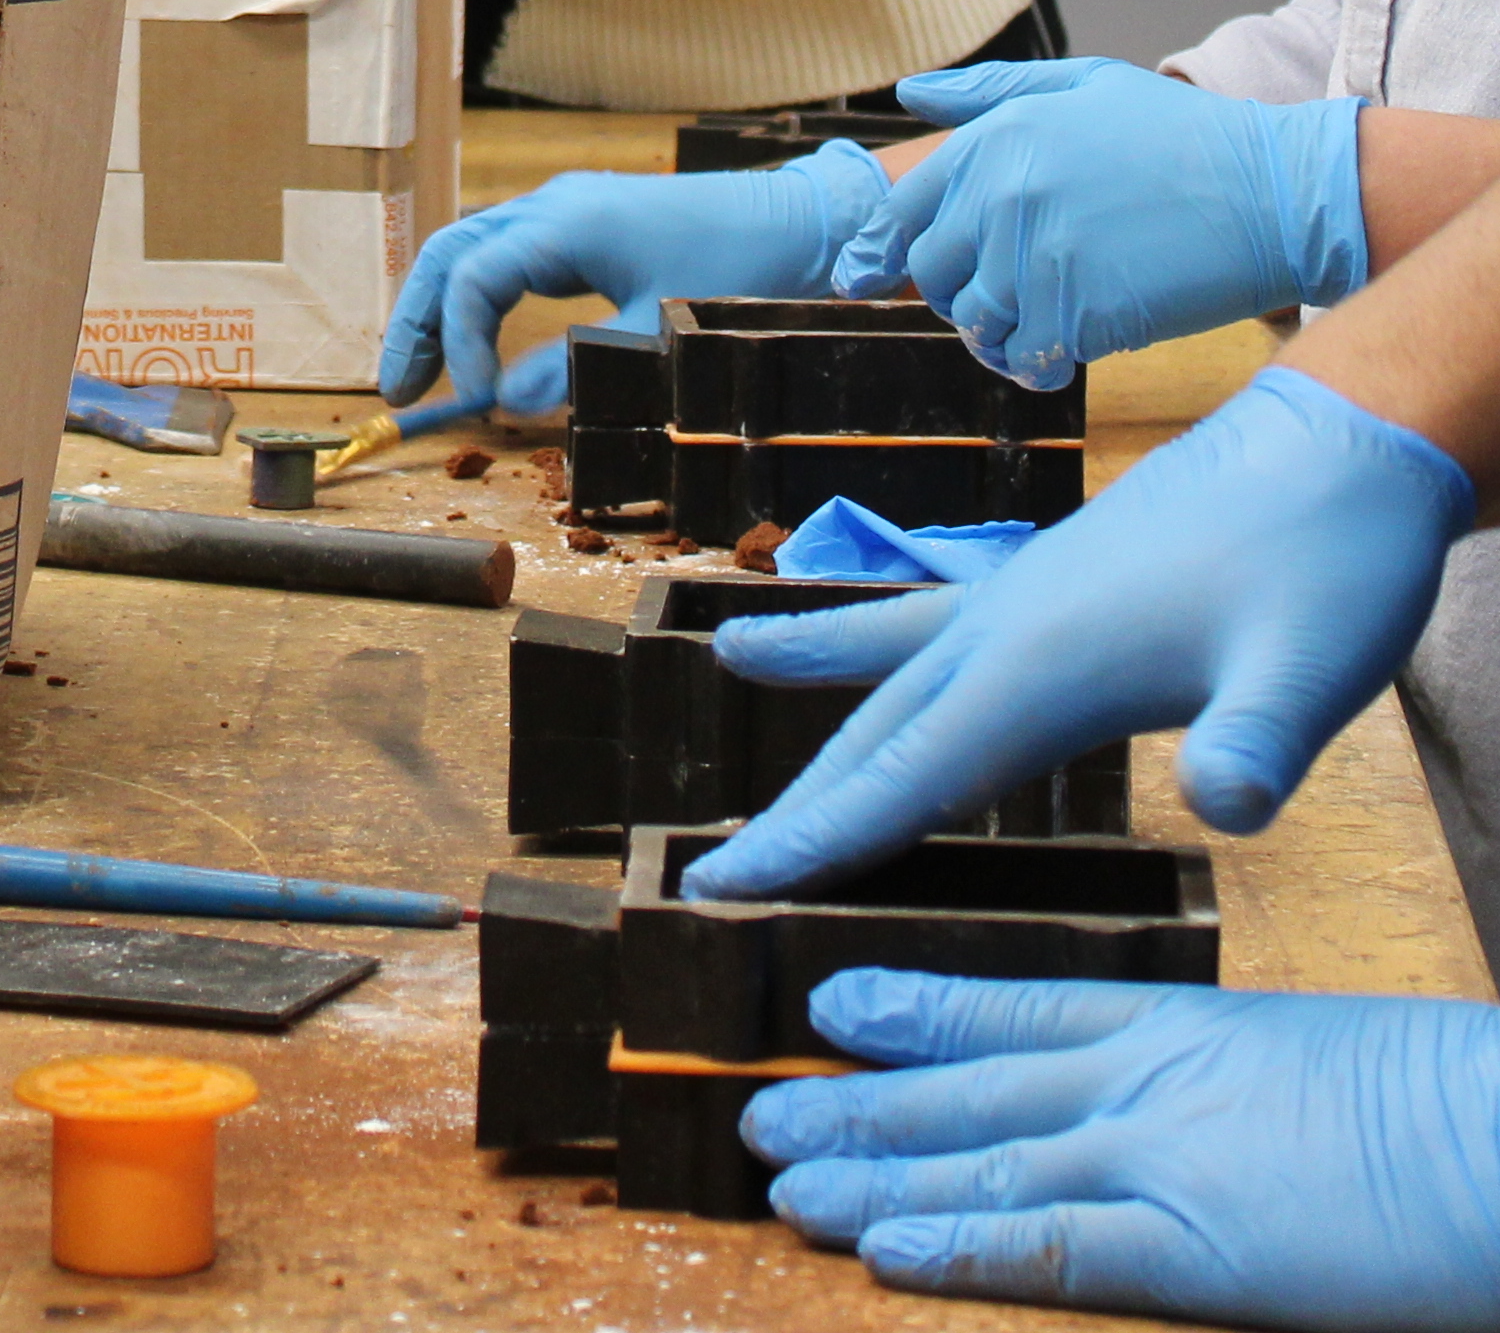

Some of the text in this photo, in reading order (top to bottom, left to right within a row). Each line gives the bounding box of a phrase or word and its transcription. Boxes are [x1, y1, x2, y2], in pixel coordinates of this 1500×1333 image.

[137, 308, 198, 320] Precious
[202, 306, 254, 320] Serving
[84, 323, 254, 343] INTERNATION
